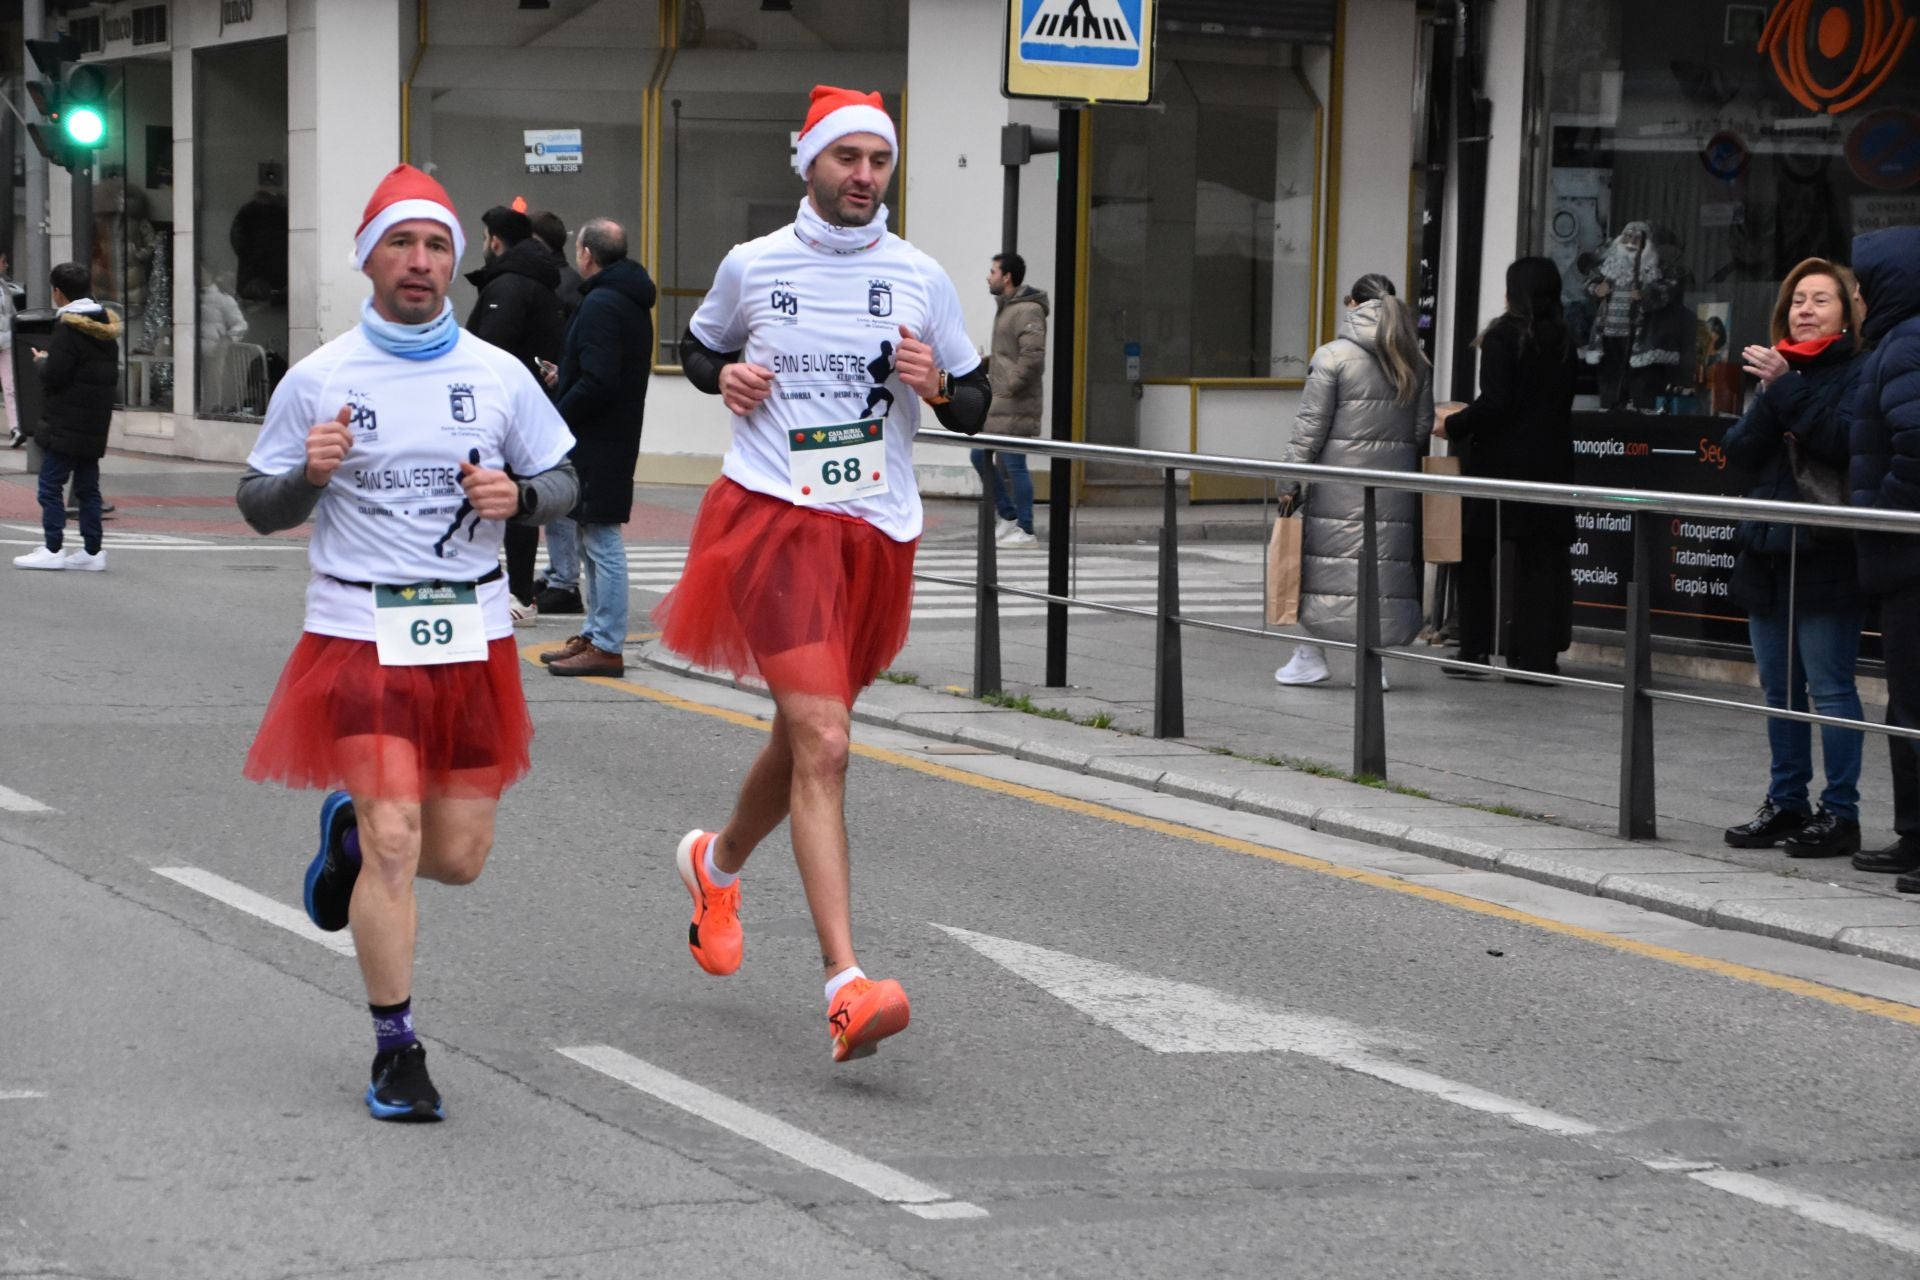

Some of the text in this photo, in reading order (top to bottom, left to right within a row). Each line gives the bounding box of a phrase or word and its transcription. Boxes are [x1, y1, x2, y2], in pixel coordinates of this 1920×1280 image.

[774, 353, 866, 373] SAN SILVESTRE
[354, 467, 455, 489] SAN SILVESTRE
[822, 457, 861, 485] 68
[1596, 512, 1632, 532] infantil
[1670, 546, 1735, 569] Tratamiento
[1670, 573, 1708, 597] Terapia
[410, 618, 453, 646] 69
